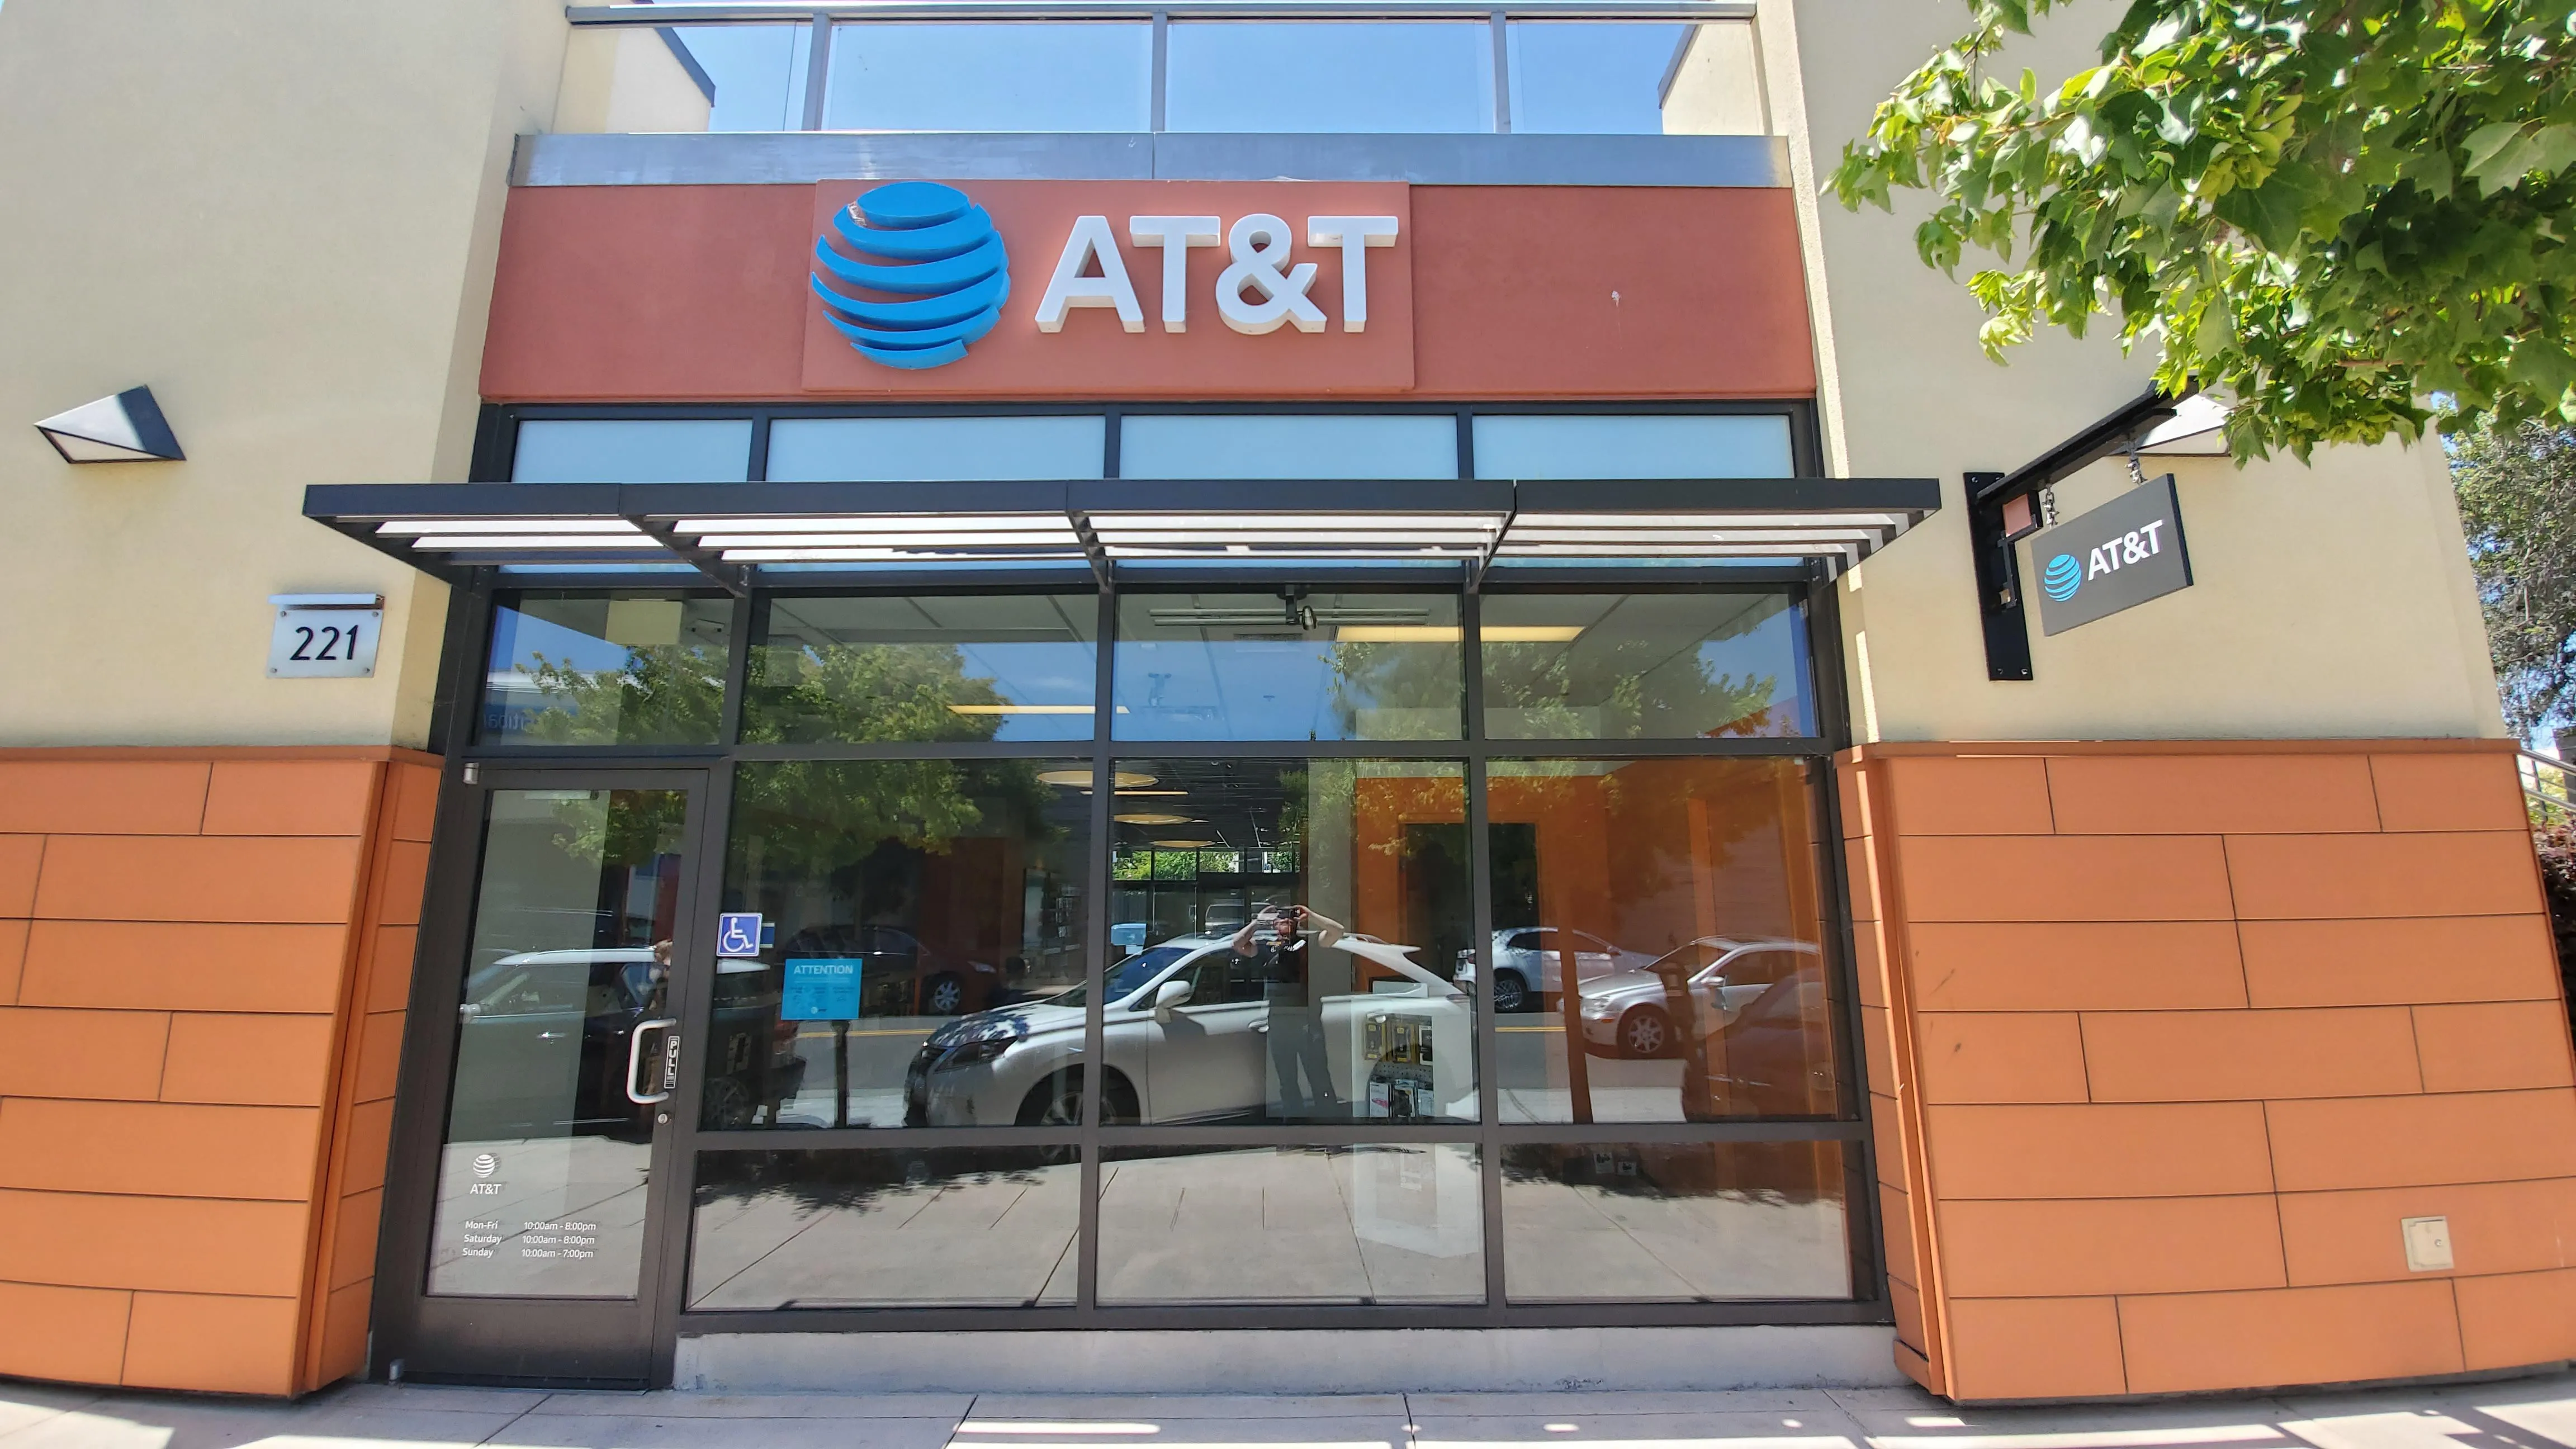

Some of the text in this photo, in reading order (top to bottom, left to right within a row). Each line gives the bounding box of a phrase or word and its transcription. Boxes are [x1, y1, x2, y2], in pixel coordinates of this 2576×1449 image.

[1035, 213, 1399, 334] AT&T
[2087, 519, 2164, 581] AT&T
[290, 624, 358, 660] 221
[793, 965, 853, 974] ATTENTION
[667, 1040, 678, 1076] PULL
[470, 1183, 501, 1195] AT&T
[465, 1220, 498, 1229] Mon-Fri
[523, 1222, 558, 1230] 10:00am
[565, 1222, 596, 1232] 8:00pm
[464, 1234, 503, 1245] Saturday
[522, 1235, 556, 1244] 10:00am
[564, 1235, 595, 1246] 8:00pm
[462, 1247, 494, 1258] Sunday
[521, 1248, 555, 1257] 10:00am
[564, 1249, 594, 1259] 7:00pm
